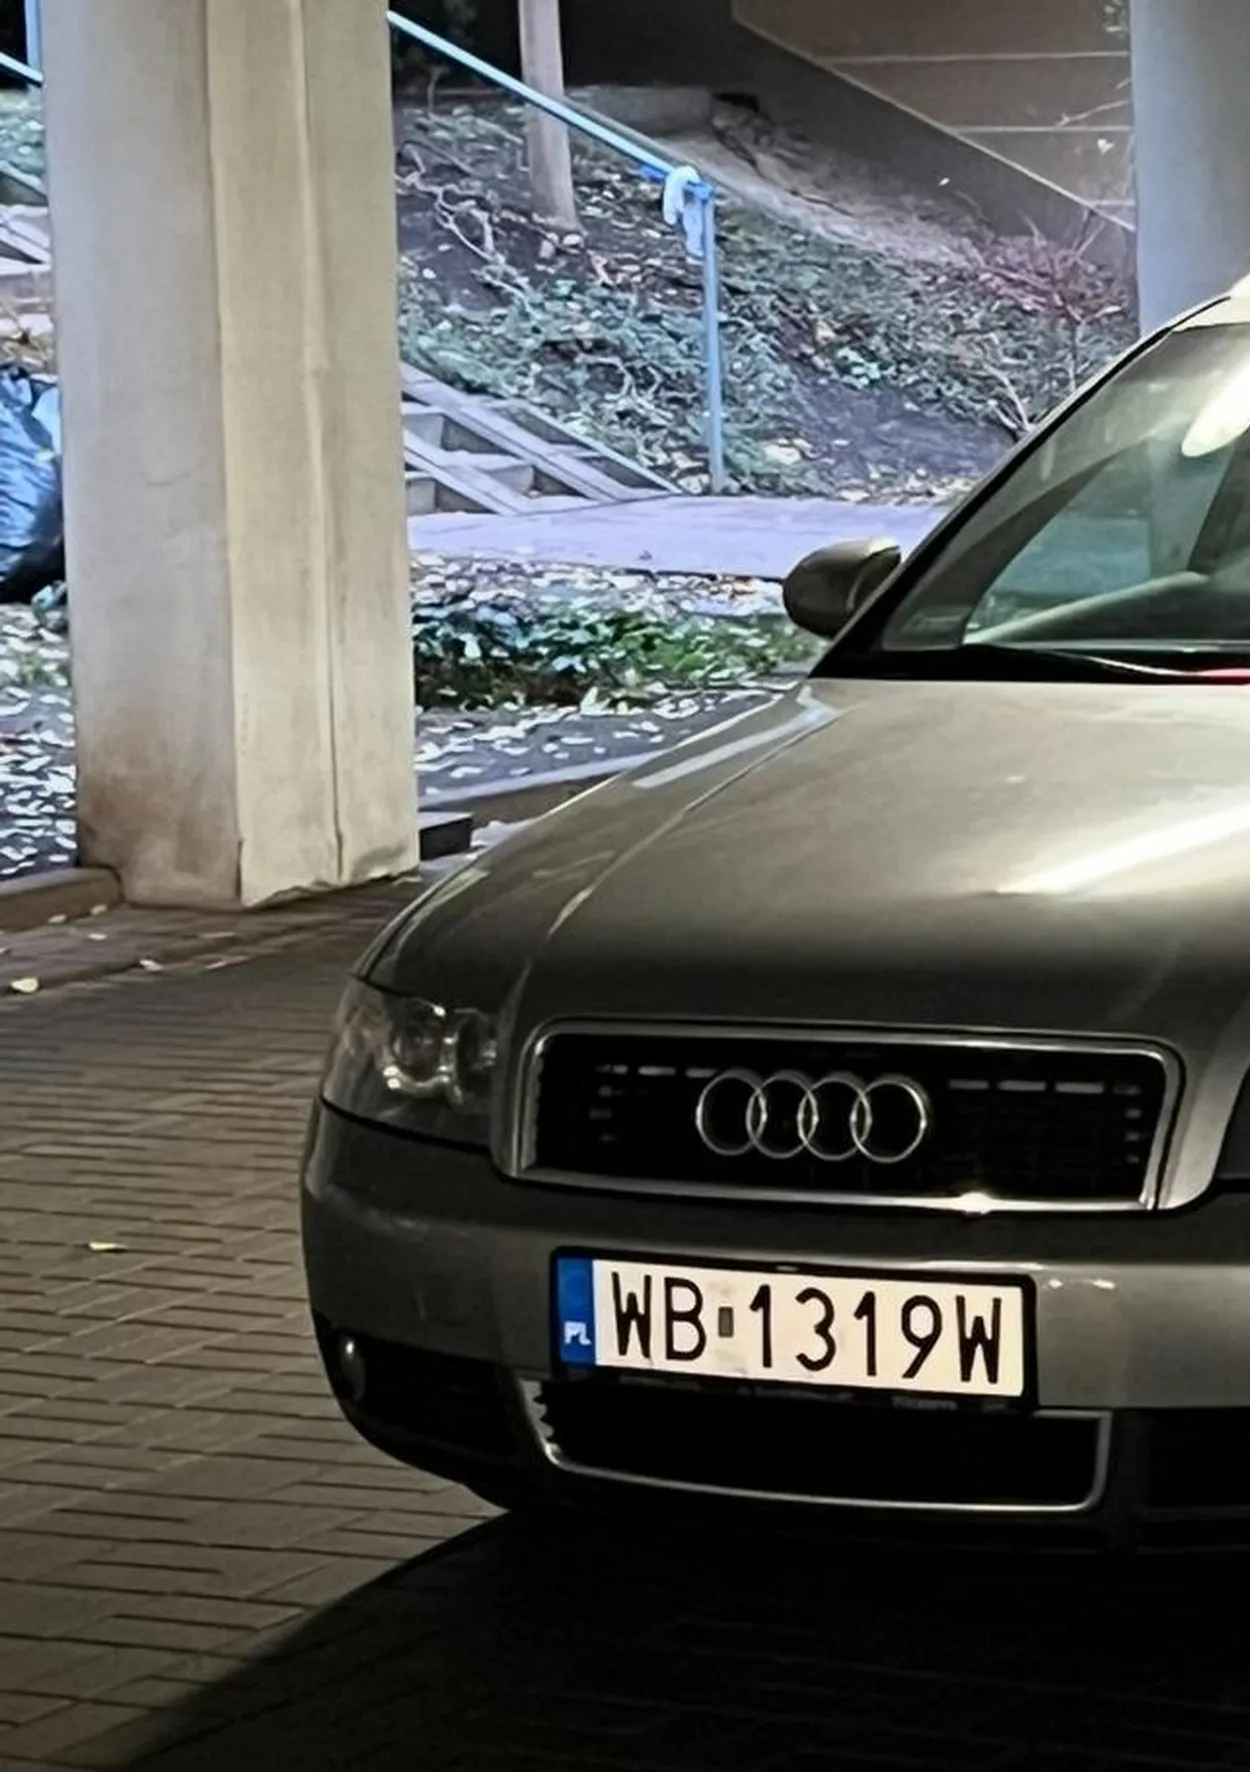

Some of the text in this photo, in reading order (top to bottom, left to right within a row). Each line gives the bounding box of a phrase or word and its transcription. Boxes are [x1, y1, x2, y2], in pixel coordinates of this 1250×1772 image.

[564, 1321, 592, 1347] PL
[611, 1271, 1003, 1384] WB 1319W
